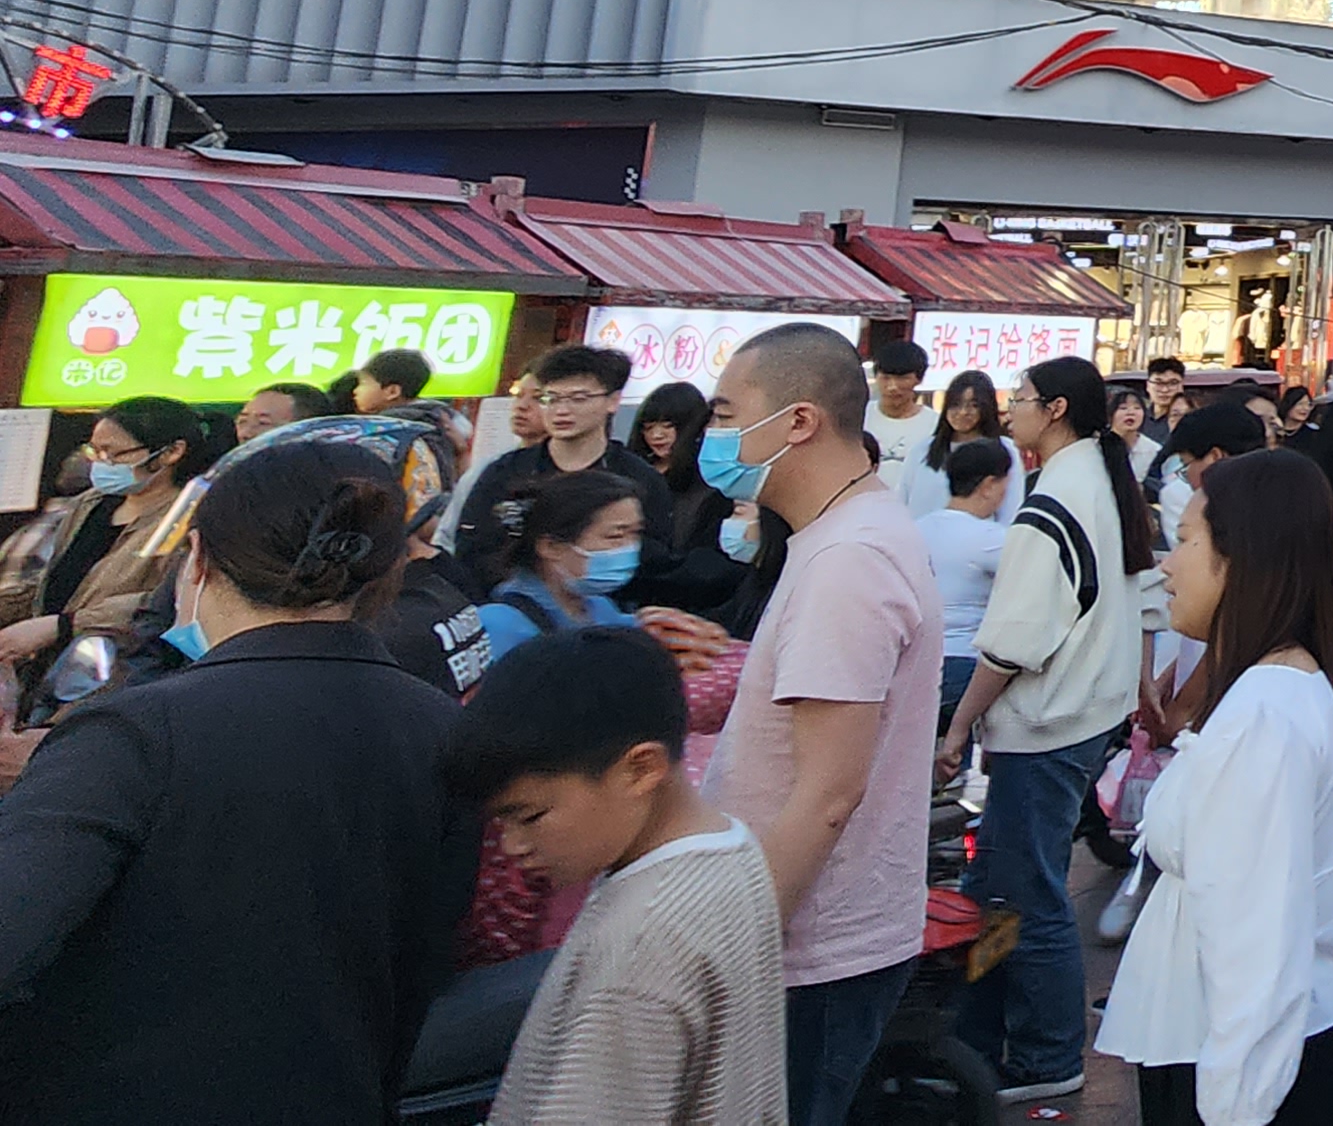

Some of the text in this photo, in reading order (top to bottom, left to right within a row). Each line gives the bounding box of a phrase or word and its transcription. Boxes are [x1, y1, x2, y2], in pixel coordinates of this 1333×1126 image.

[25, 44, 112, 118] 市
[173, 295, 492, 378] 紫米饭团
